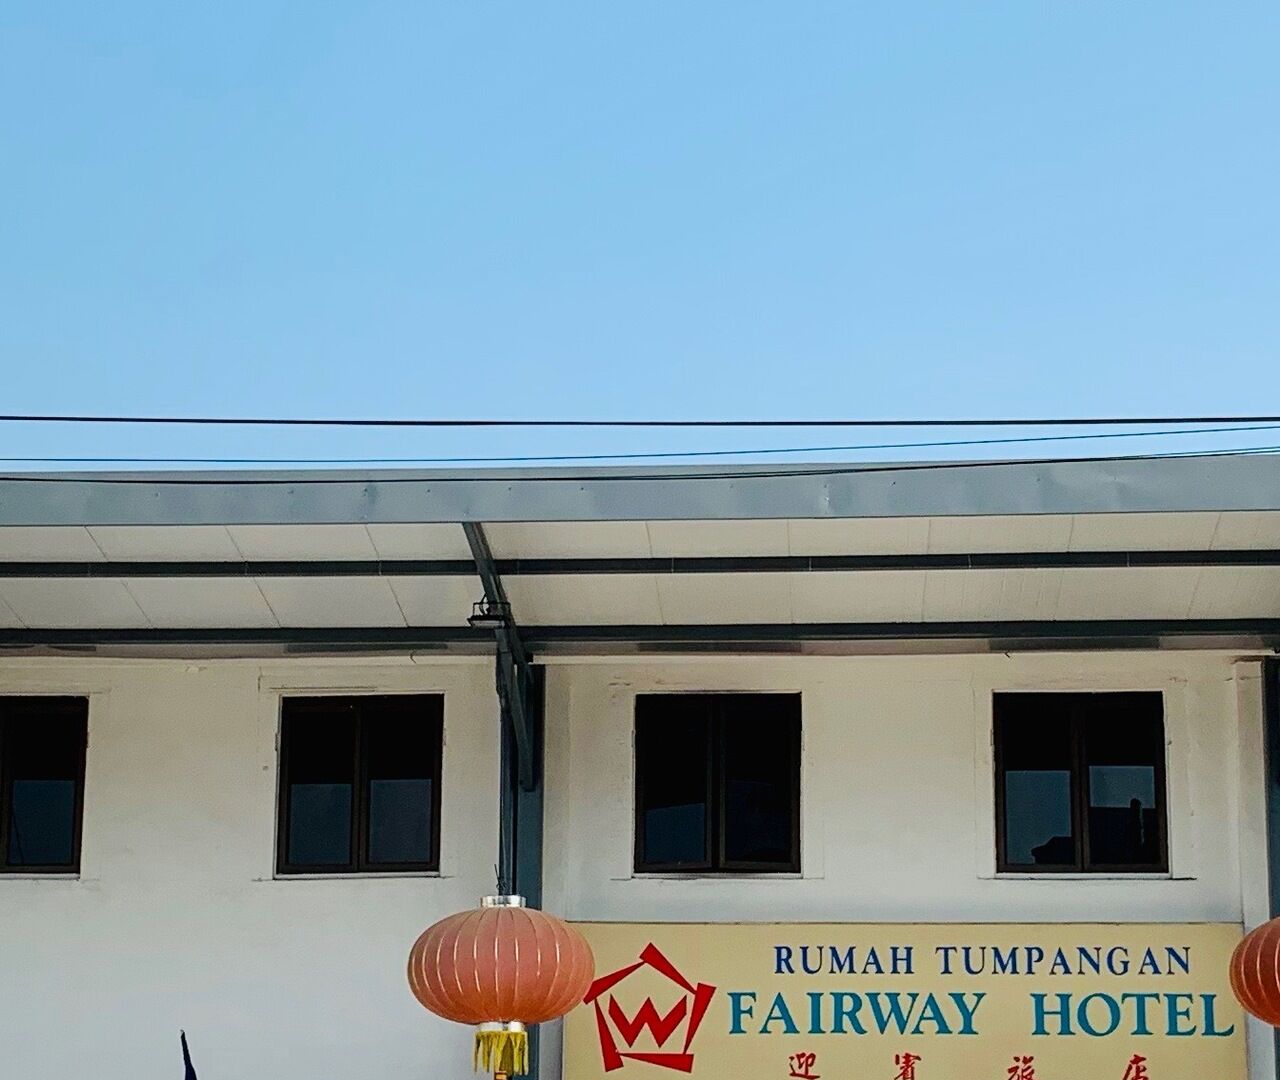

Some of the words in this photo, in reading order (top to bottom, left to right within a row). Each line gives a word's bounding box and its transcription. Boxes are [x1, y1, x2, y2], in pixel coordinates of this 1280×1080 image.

[773, 945, 915, 975] RUMAH
[934, 946, 1192, 976] TUMPANGAN
[728, 991, 985, 1037] FAIRWAY
[1031, 991, 1235, 1038] HOTEL
